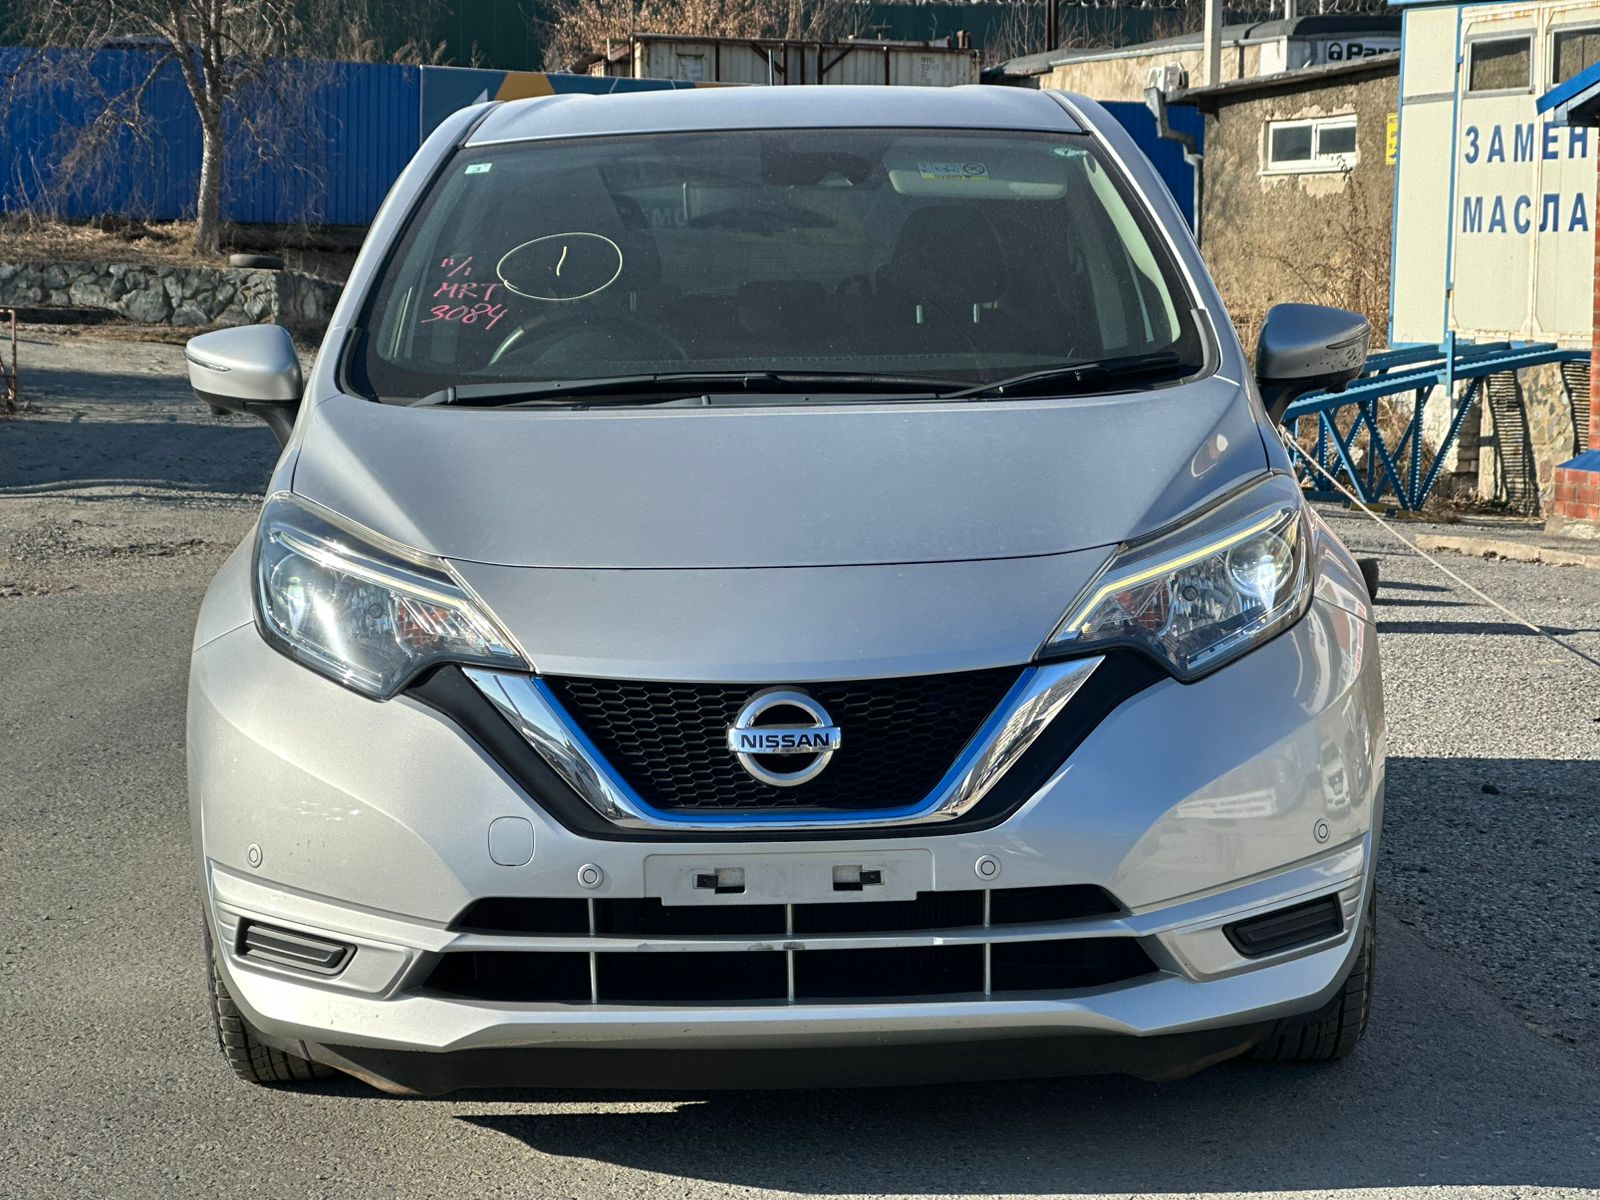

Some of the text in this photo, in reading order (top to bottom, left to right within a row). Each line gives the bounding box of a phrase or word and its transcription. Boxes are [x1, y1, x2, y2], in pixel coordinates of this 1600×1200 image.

[1462, 192, 1589, 234] МАСЛА
[433, 281, 503, 301] MRT
[420, 302, 508, 330] 3084
[740, 732, 830, 748] NISSAN
